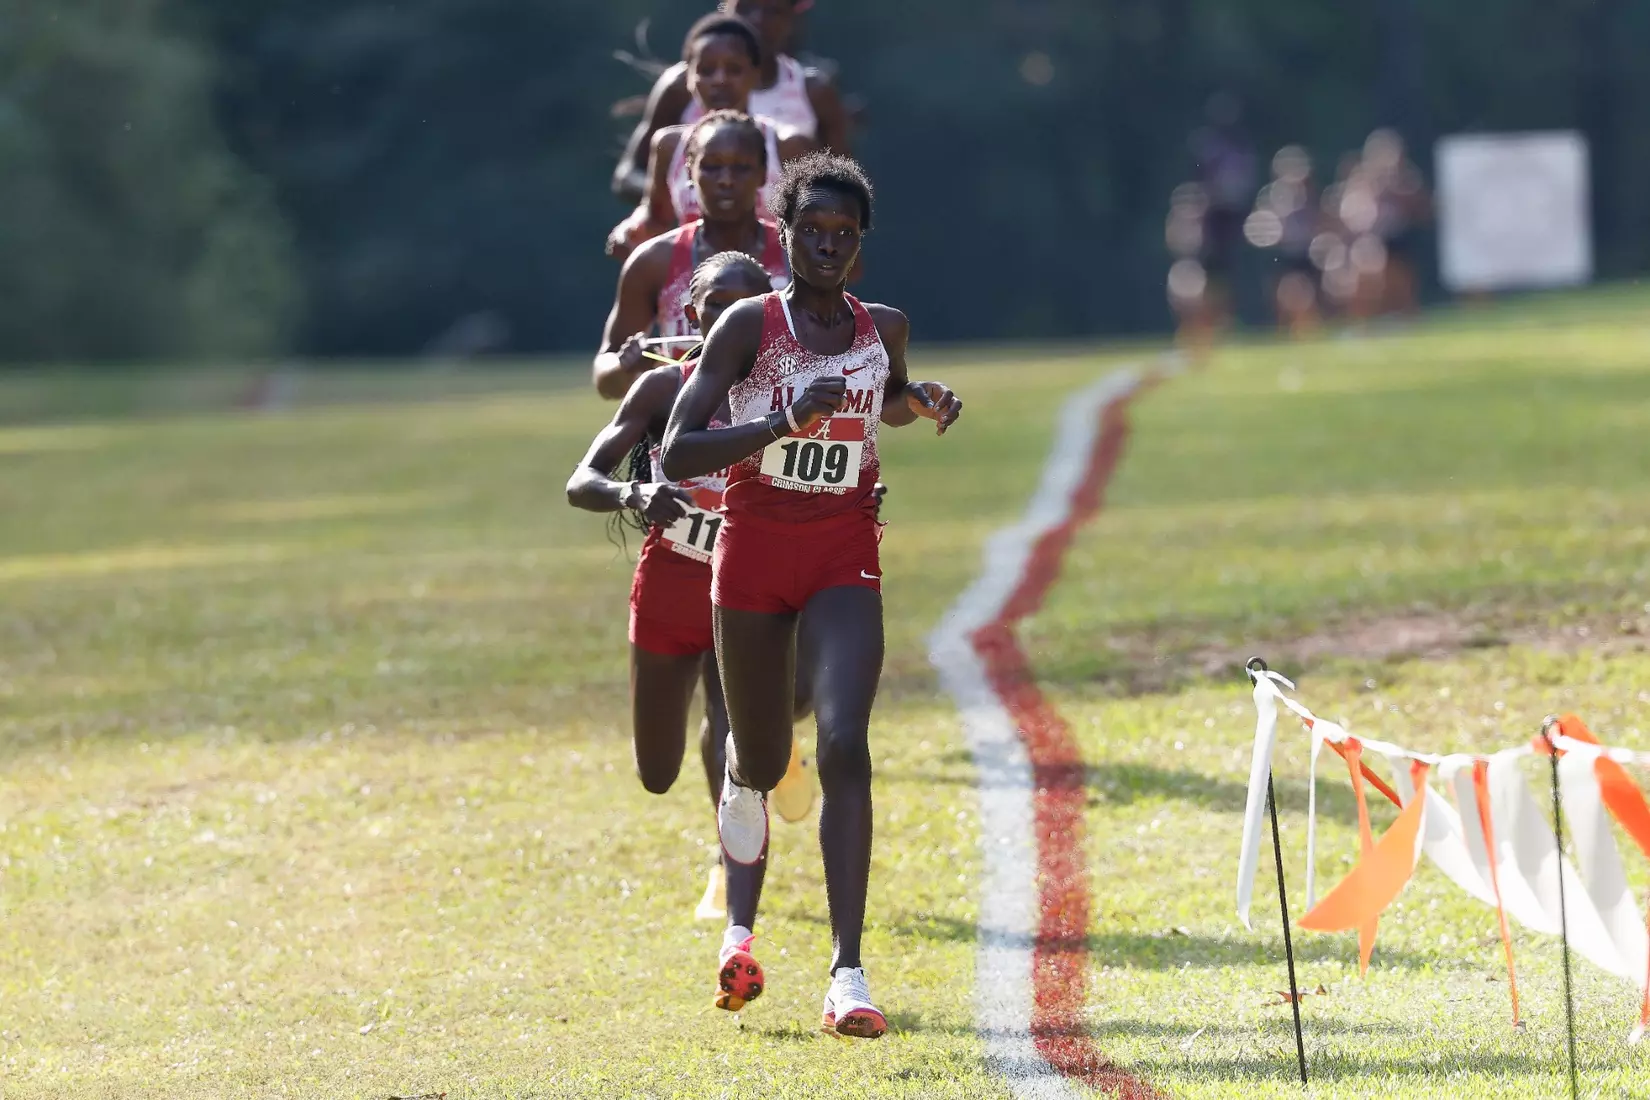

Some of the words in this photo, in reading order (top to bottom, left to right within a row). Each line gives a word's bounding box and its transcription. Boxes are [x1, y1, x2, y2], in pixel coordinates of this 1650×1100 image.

[779, 356, 797, 375] SEC
[770, 387, 874, 414] ALMA
[808, 419, 831, 440] A
[781, 441, 849, 484] 109
[771, 477, 811, 493] CRIMSON
